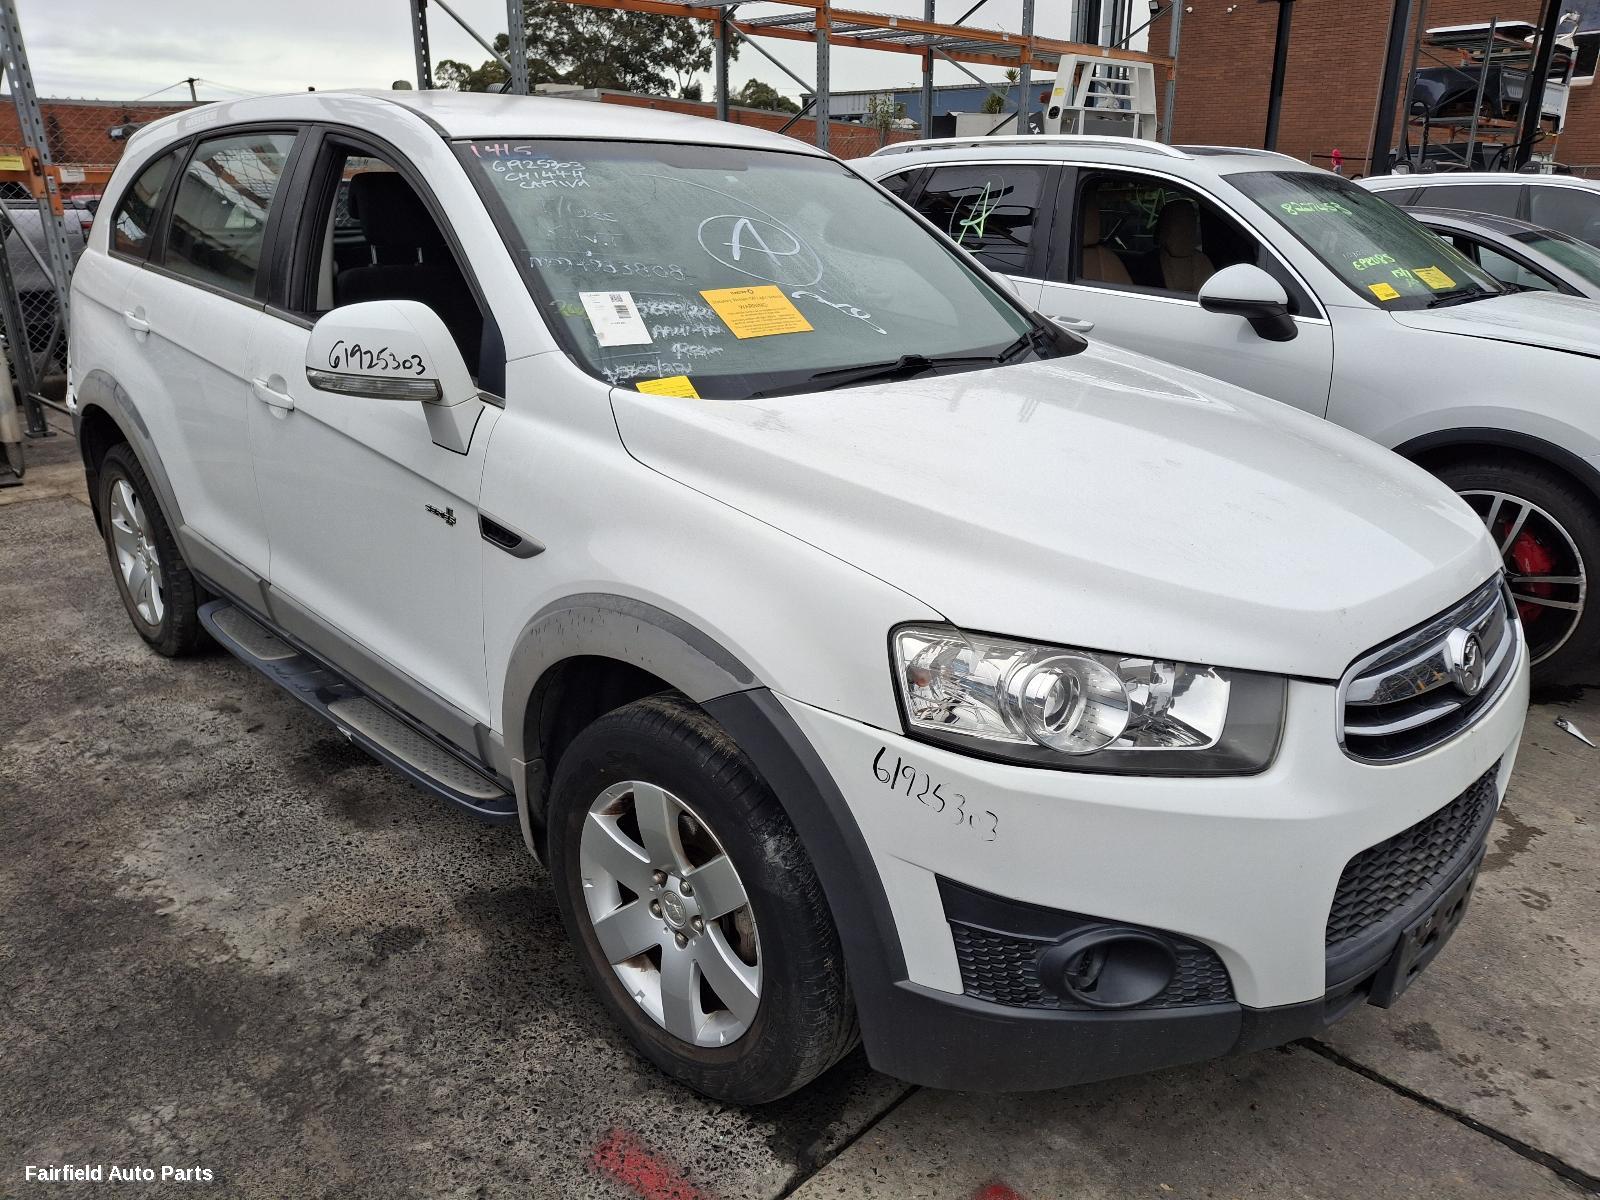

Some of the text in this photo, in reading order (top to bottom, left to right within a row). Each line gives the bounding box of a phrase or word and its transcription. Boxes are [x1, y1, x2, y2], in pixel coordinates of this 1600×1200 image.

[519, 179, 591, 189] CAPTIVA
[722, 217, 786, 267] A
[328, 340, 426, 376] 61925303
